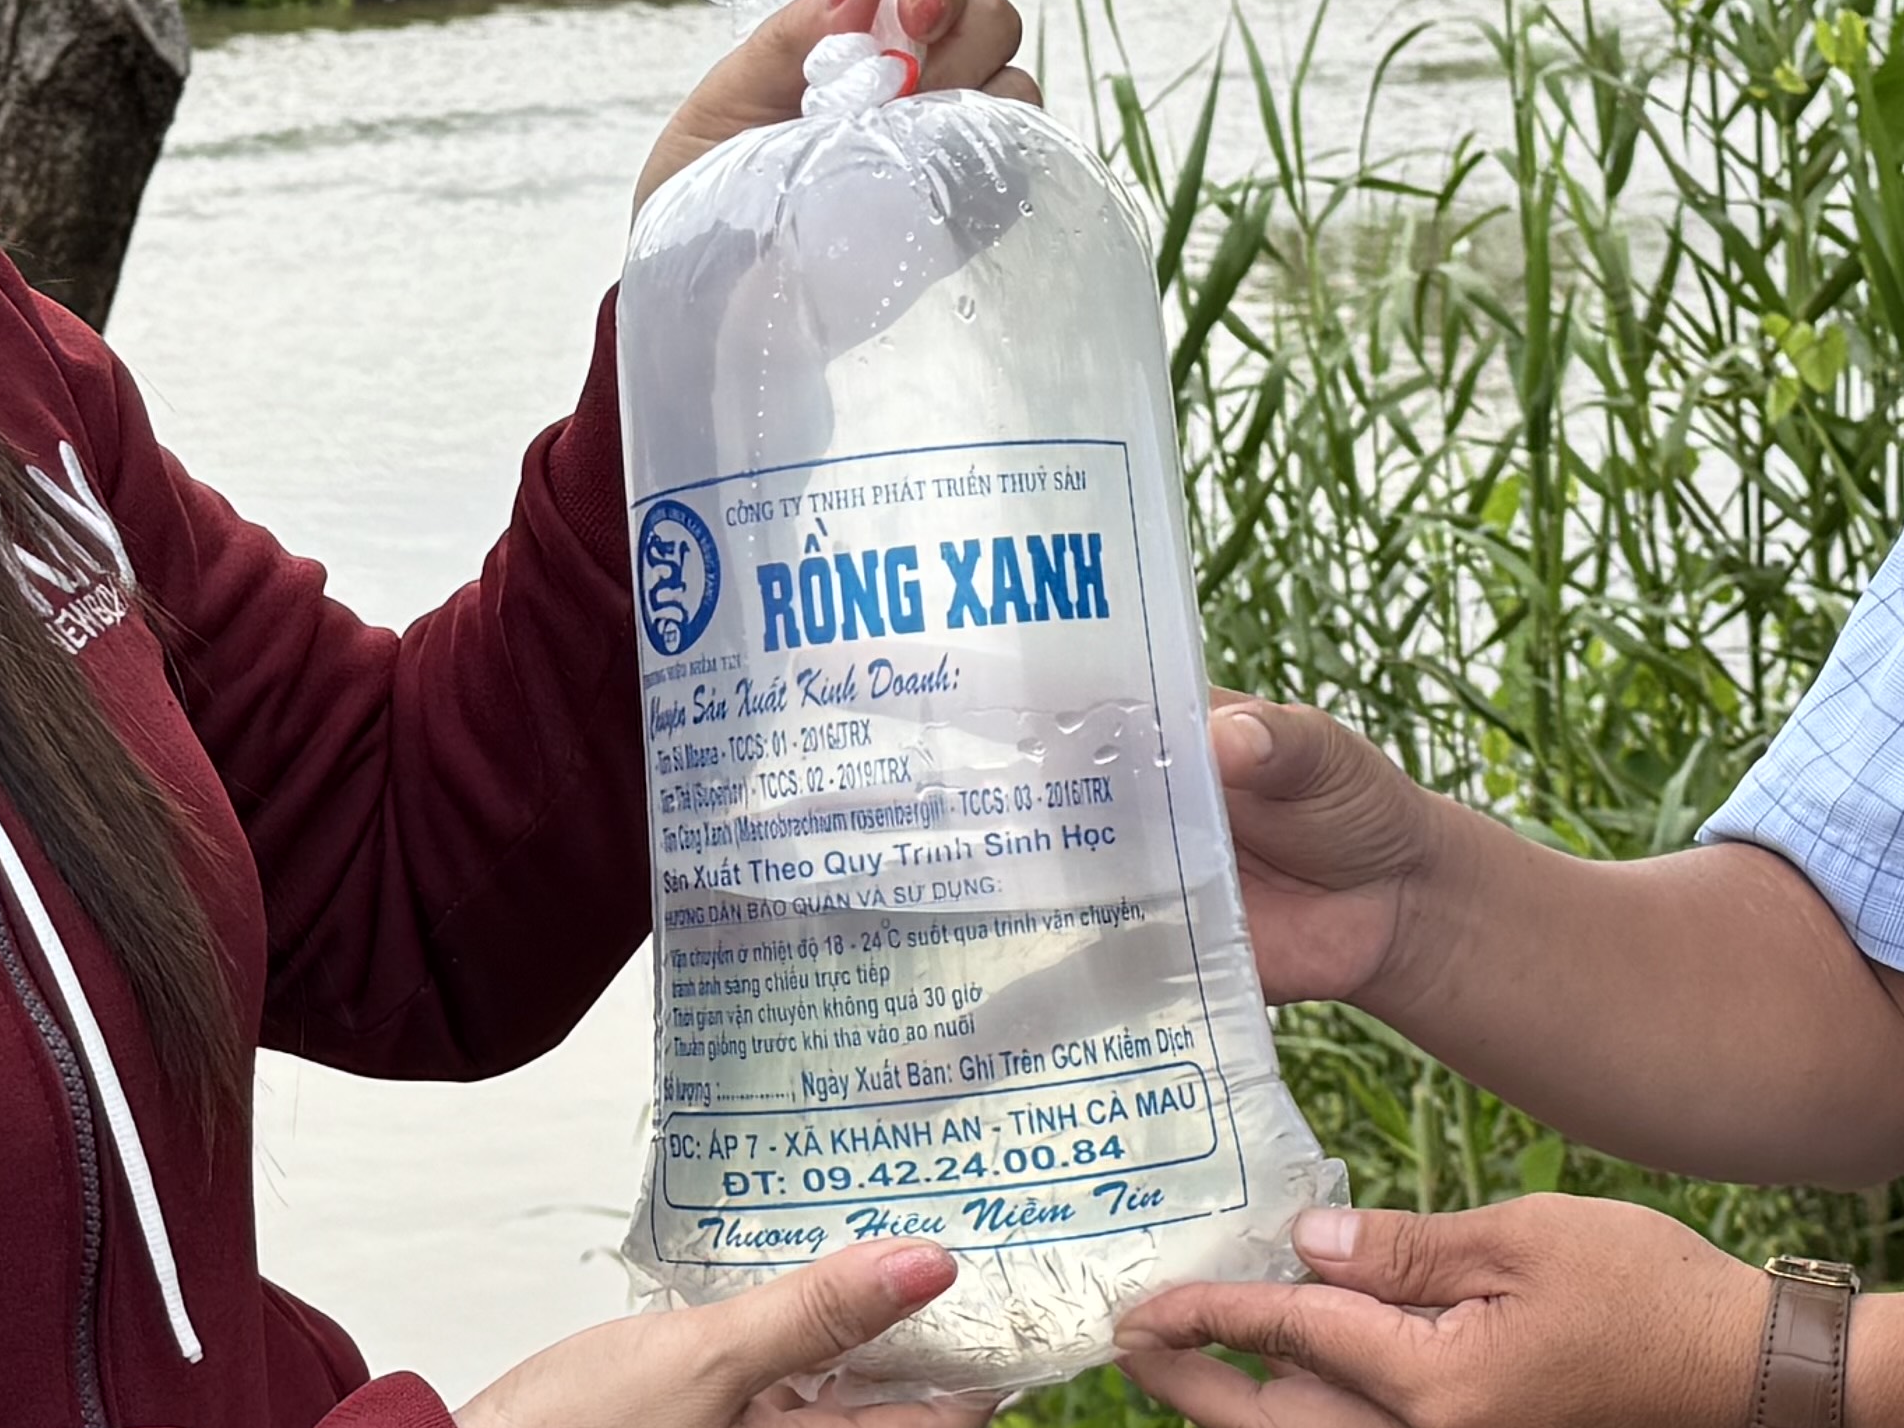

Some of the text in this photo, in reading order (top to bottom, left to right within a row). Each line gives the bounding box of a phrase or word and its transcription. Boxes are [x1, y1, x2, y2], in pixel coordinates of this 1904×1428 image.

[780, 495, 803, 518] TY
[808, 486, 865, 514] TNHH
[873, 475, 927, 505] PHÁT
[756, 517, 926, 653] RỒNG
[939, 532, 1110, 630] XANH
[735, 675, 788, 718] Xuất
[796, 663, 857, 708] Kinh
[867, 651, 960, 699] Doanh:
[728, 732, 769, 763] TCCS:
[772, 729, 788, 758] 01
[758, 769, 804, 800] TCCS:
[807, 765, 825, 793] 02
[959, 786, 1010, 817] TCCS:
[1013, 783, 1033, 812] 03
[694, 855, 743, 890] Xuất
[747, 858, 814, 886] Theo
[824, 850, 883, 877] Quy
[984, 828, 1052, 858] Sinh
[1061, 824, 1117, 852] Học
[931, 875, 1003, 902] DỤNG:
[752, 940, 794, 966] nhiệt
[796, 936, 820, 963] độ
[824, 933, 844, 957] 18
[815, 966, 852, 993] trực
[822, 994, 879, 1020] không
[923, 985, 946, 1009] 30
[801, 1029, 829, 1051] khi
[905, 1023, 928, 1042] ao
[800, 1069, 849, 1103] Ngày
[854, 1057, 902, 1093] Xuất
[958, 1052, 996, 1082] Ghi
[998, 1047, 1047, 1077] Trên
[1051, 1037, 1098, 1071] GCN
[1102, 1025, 1154, 1062] Kiểm
[1155, 1024, 1196, 1059] Dịch
[669, 1132, 702, 1160] ĐC:
[744, 1133, 759, 1160] 7
[784, 1125, 824, 1158] XÃ
[831, 1118, 933, 1155] KHÁNH
[941, 1115, 983, 1145] AN
[1085, 1089, 1129, 1126] CÀ
[1135, 1081, 1197, 1119] MAU
[722, 1134, 1126, 1198] ĐT: 09.42.24.00.84
[961, 1195, 1076, 1232] Niềm
[1092, 1179, 1166, 1216] Tin
